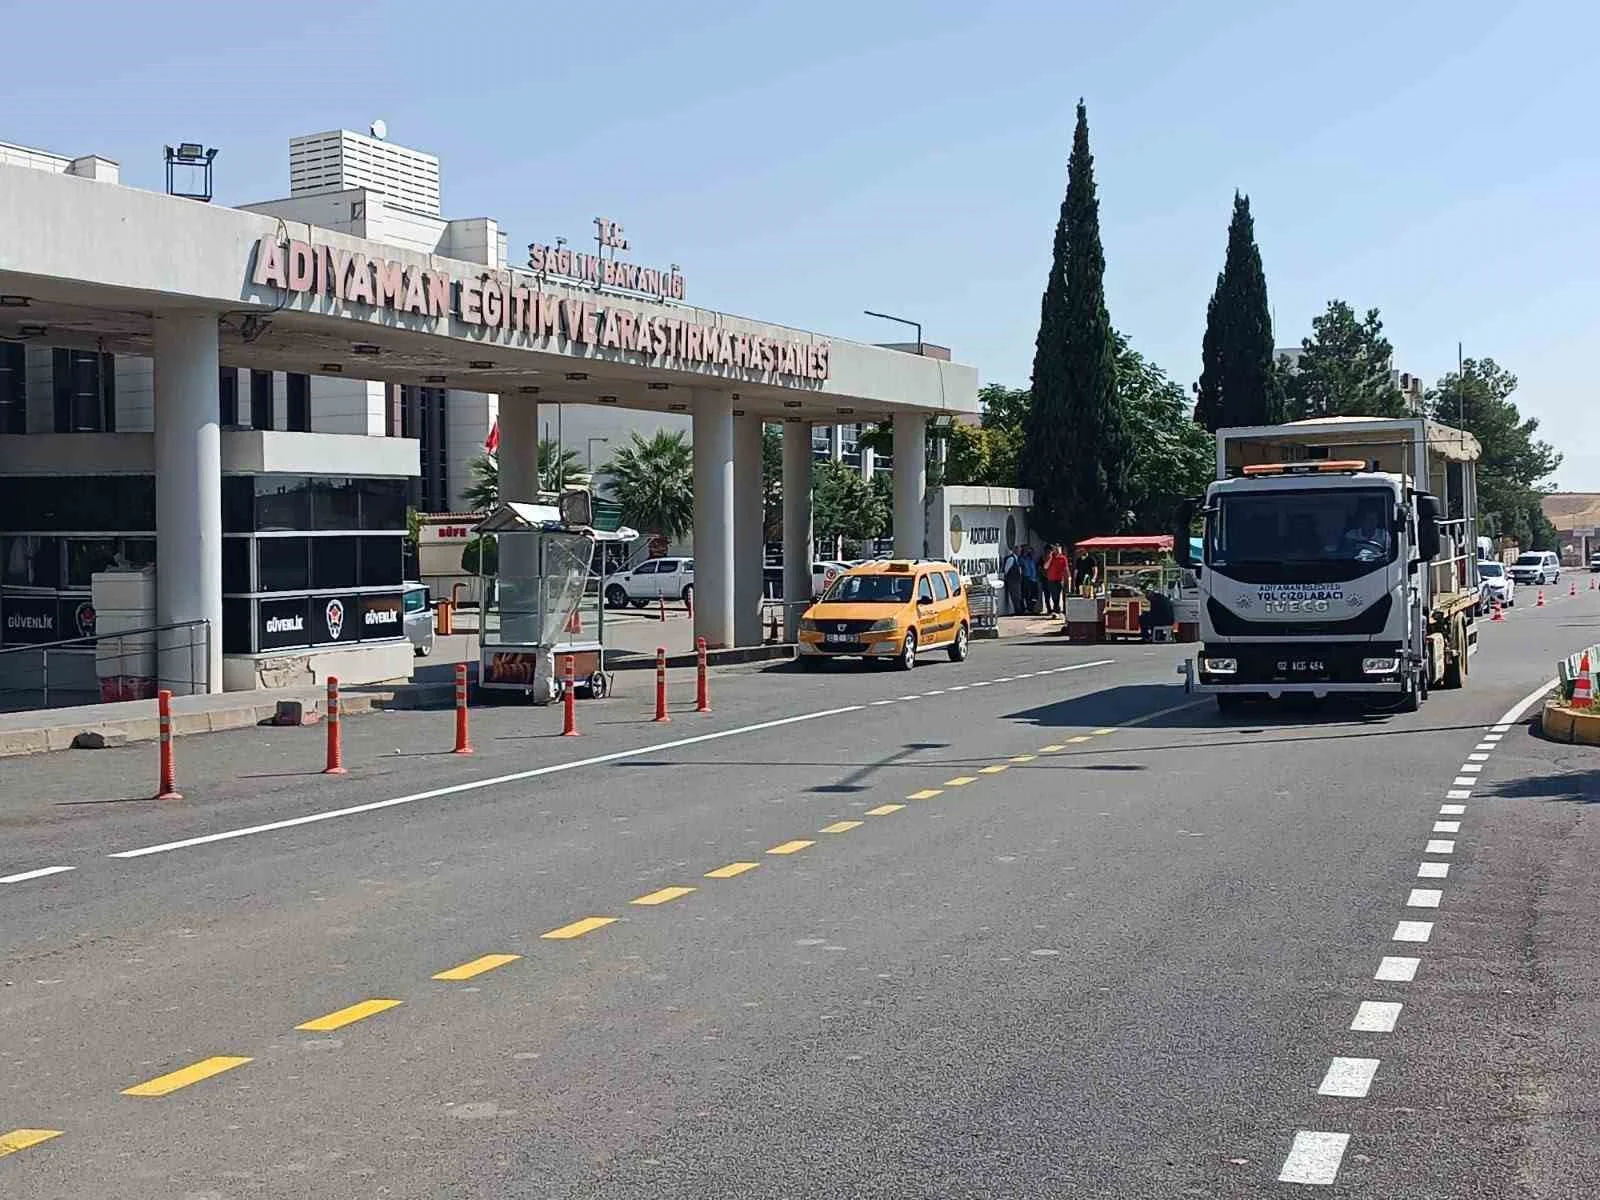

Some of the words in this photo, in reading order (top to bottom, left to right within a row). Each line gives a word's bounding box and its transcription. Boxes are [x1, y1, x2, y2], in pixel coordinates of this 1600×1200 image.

[528, 236, 598, 285] SAĞLIK
[603, 257, 687, 300] BAKANLIĞI
[251, 233, 450, 318] ADIYAMAN
[566, 300, 599, 346] VE
[602, 308, 733, 368] ARAŞTIRMA
[734, 333, 833, 380] HASTANESİ
[438, 525, 466, 537] BÜFE
[1257, 591, 1278, 601] YOL
[8, 613, 53, 629] GÜVENLİK
[266, 614, 304, 633] GÜVENLİK
[365, 608, 398, 625] GÜVENLİK
